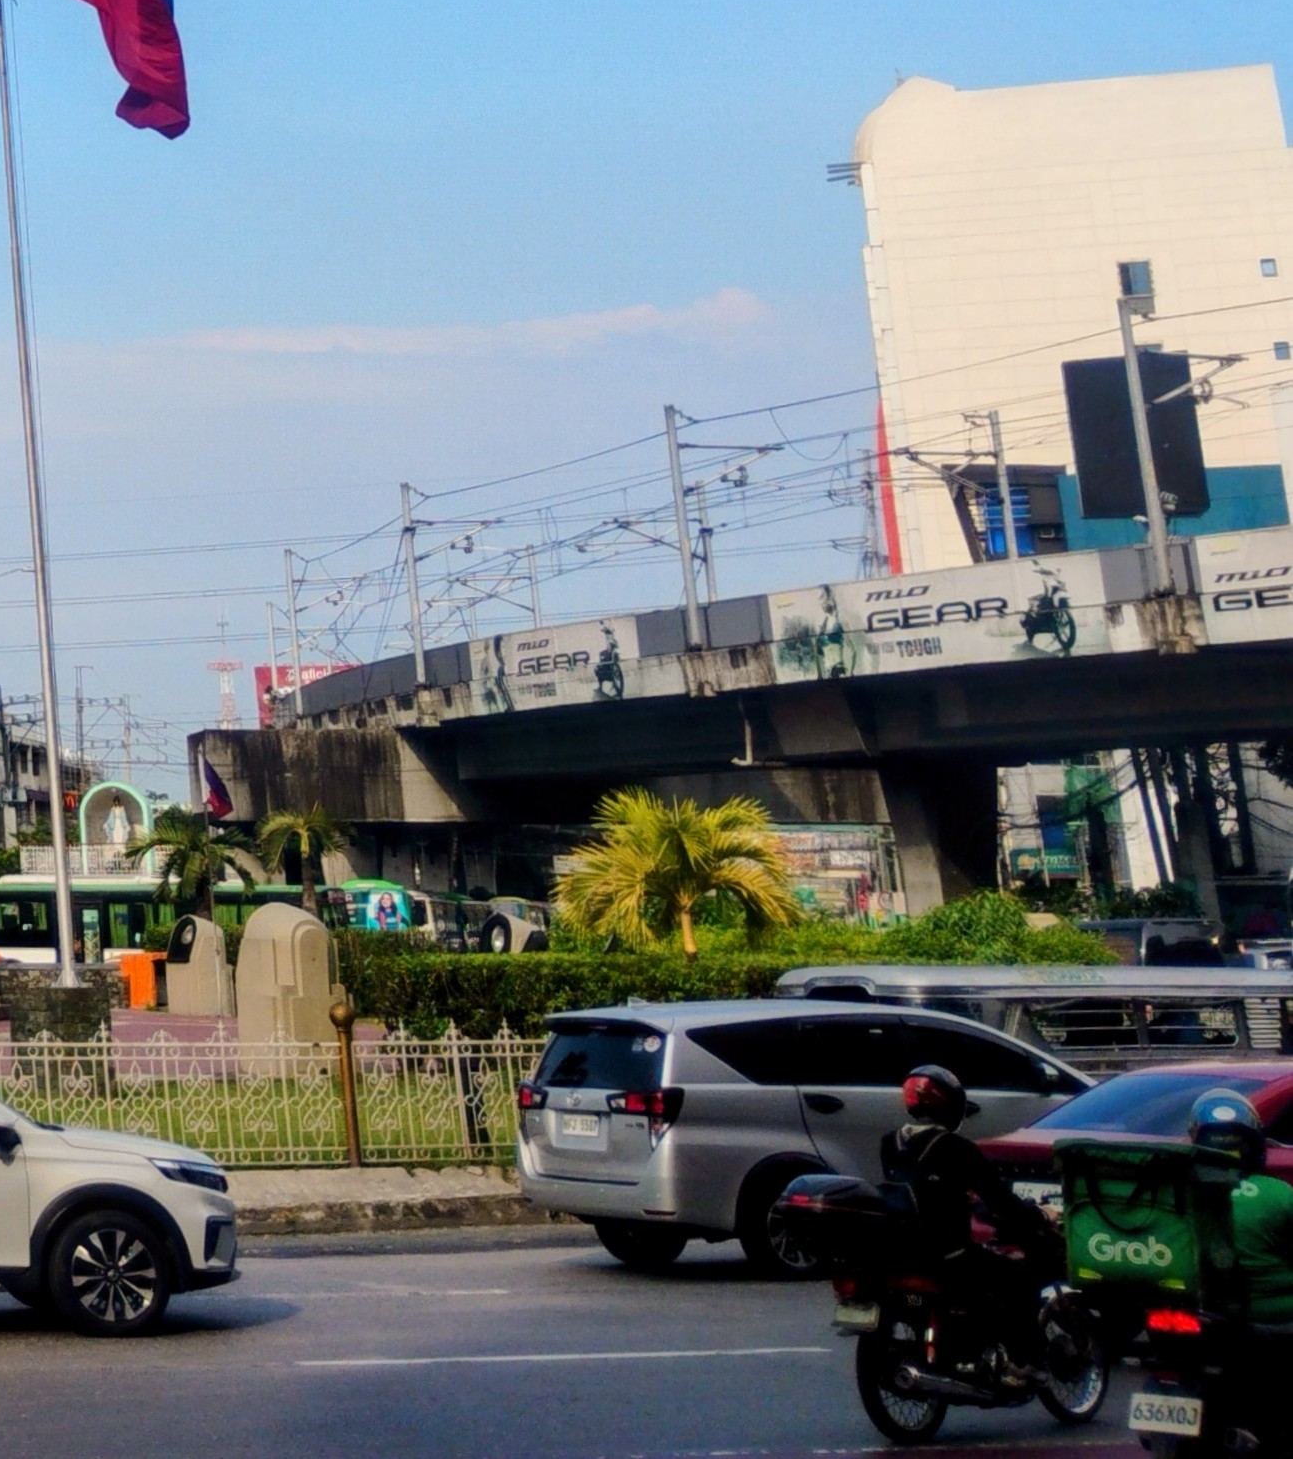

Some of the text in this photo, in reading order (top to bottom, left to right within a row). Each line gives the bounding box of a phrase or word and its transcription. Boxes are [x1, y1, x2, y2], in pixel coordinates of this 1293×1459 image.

[866, 597, 1008, 633] GEAR
[896, 637, 943, 658] TOUGH
[517, 651, 590, 677] GEAR
[1088, 1233, 1172, 1267] Grab
